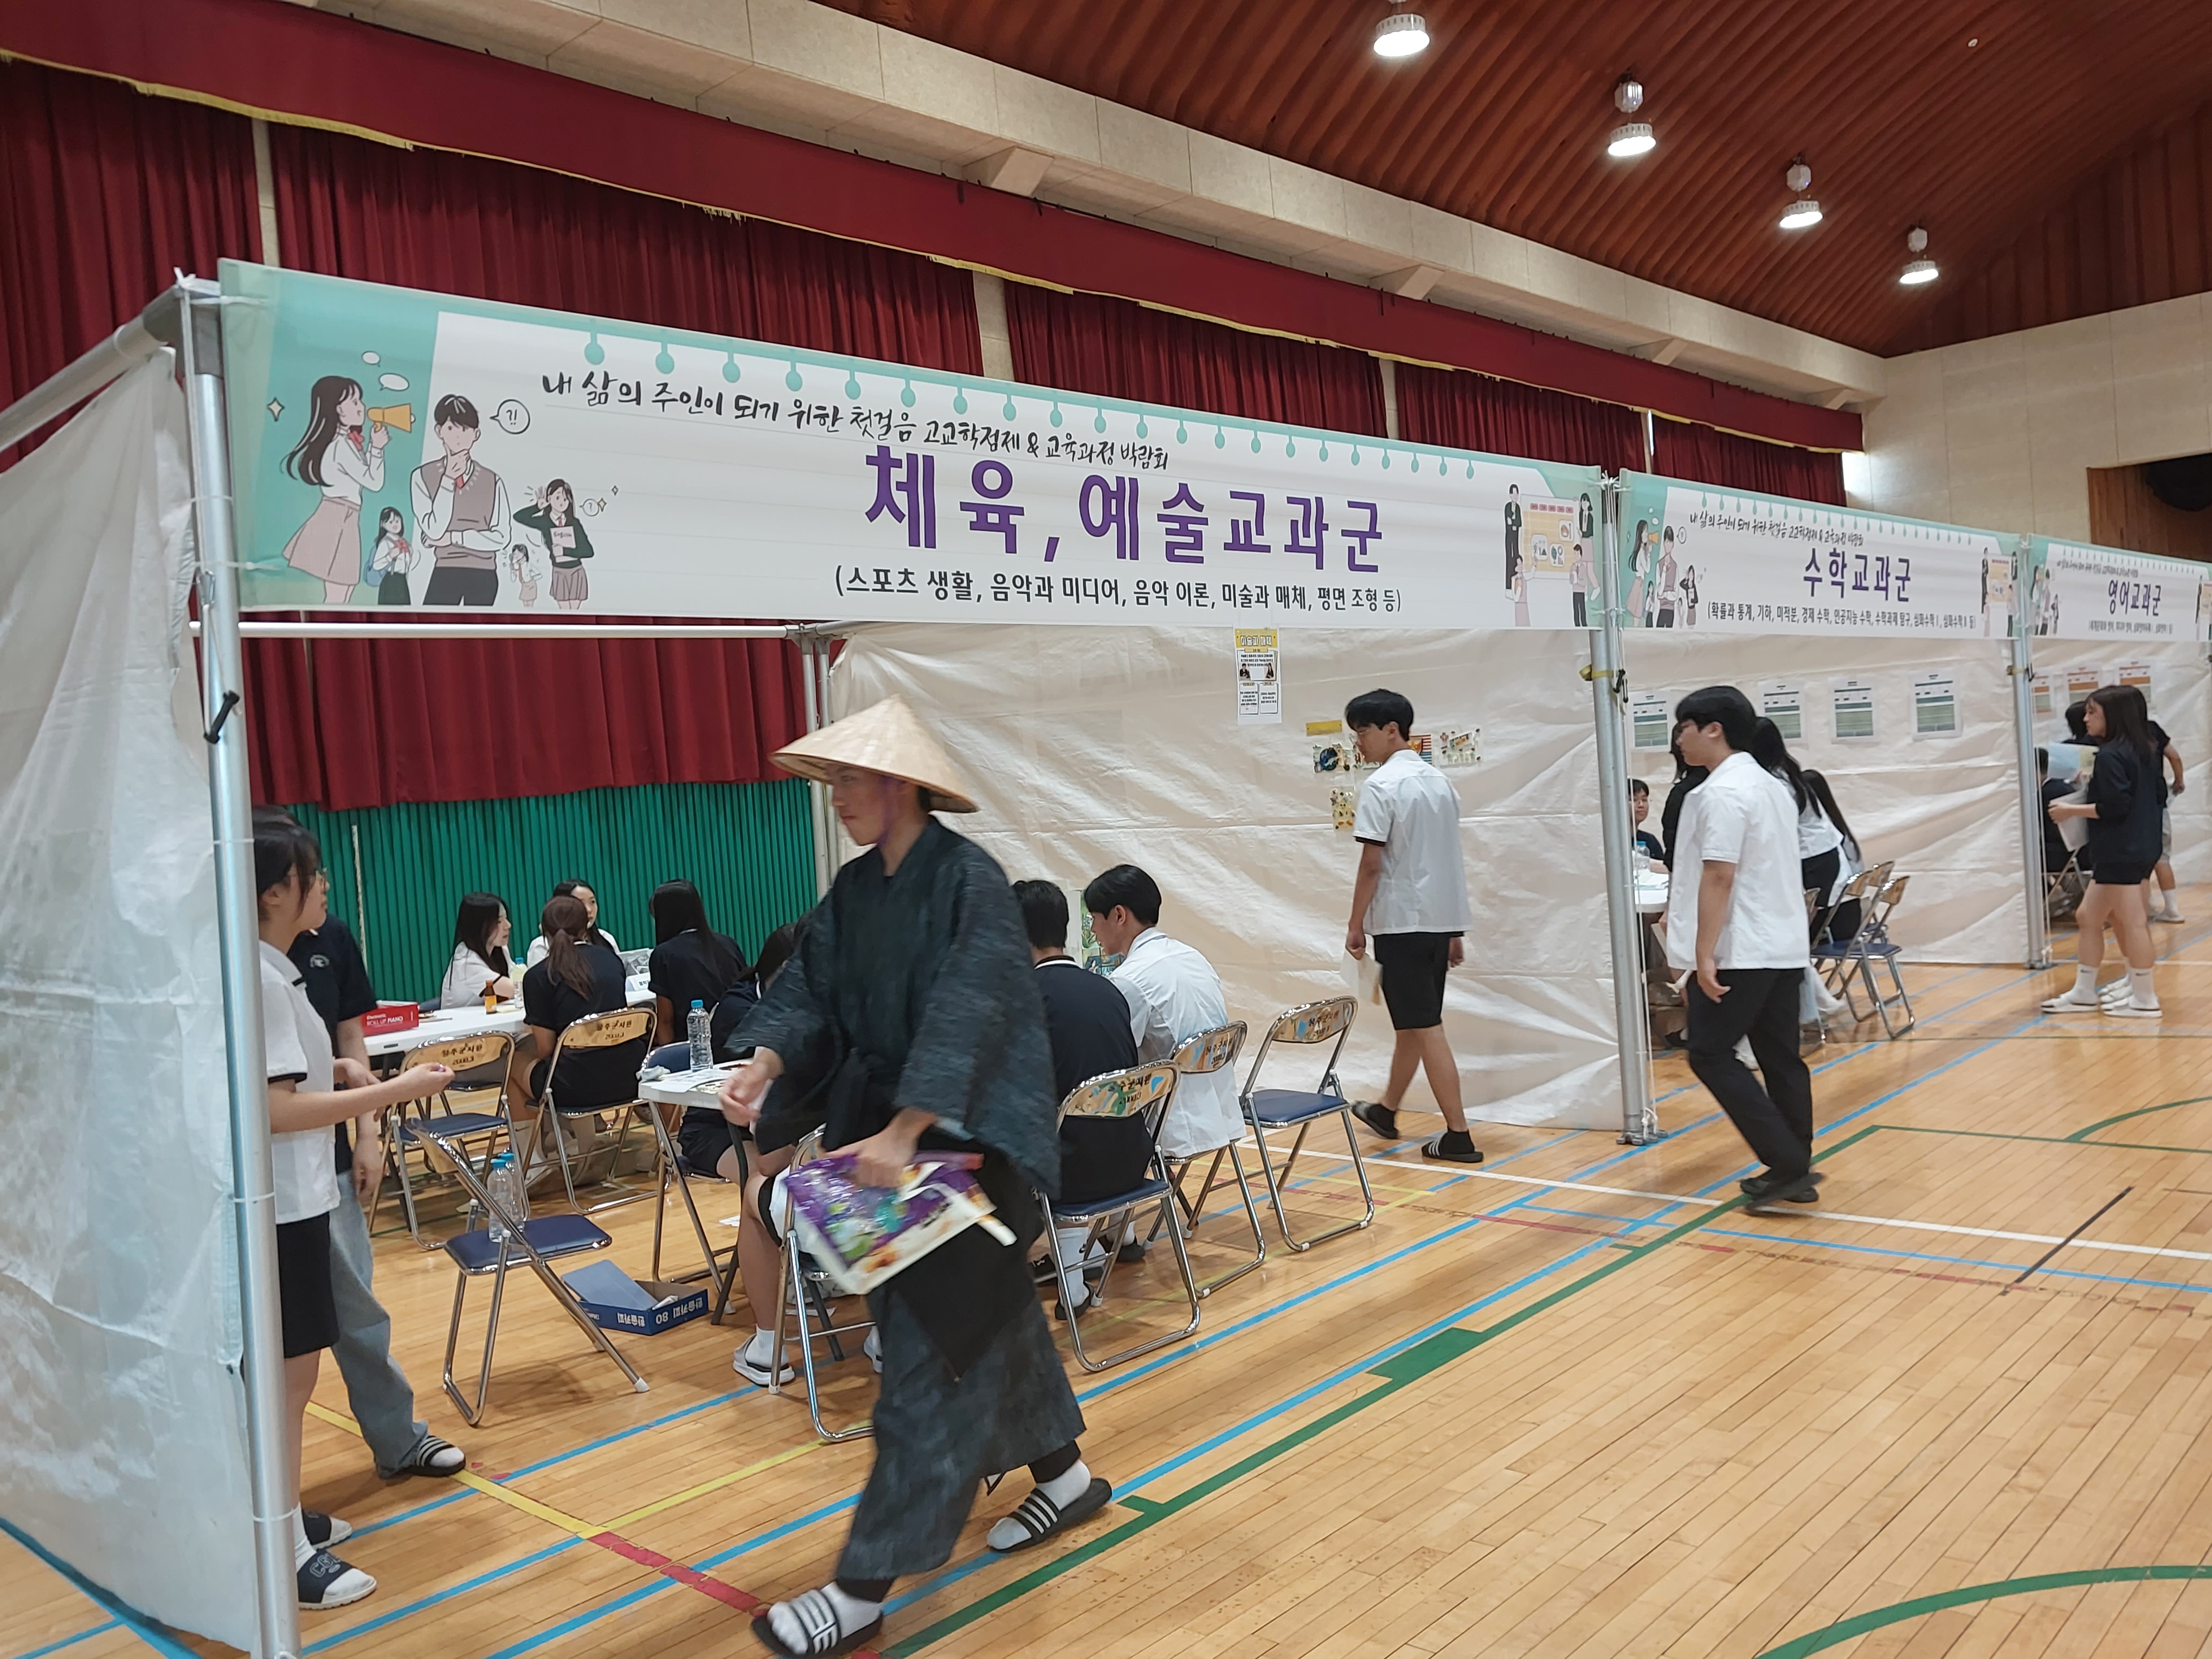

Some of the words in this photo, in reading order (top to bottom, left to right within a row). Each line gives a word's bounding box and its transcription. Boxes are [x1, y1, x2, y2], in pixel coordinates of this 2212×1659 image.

[542, 372, 571, 395] 내
[582, 370, 642, 407] 삶의
[652, 382, 723, 416] 주인이
[734, 394, 779, 422] 되기
[788, 399, 844, 432] 위한
[850, 406, 917, 442] 첫걸음
[923, 420, 1020, 453] 고교학점제
[1026, 432, 1039, 459] &
[1045, 434, 1115, 466] 교육과정
[1120, 441, 1168, 471] 박람회
[865, 445, 1060, 562] 체육,
[1079, 473, 1382, 573] 예술교과군
[1690, 512, 1697, 523] 내
[1700, 510, 1715, 529] 삶의
[1717, 515, 1735, 530] 주인이
[1738, 518, 1750, 531] 되기
[1752, 519, 1767, 536] 위한
[835, 564, 919, 597] (스포츠
[927, 569, 982, 602] 생활,
[991, 573, 1054, 602] 음악과
[1063, 576, 1127, 608] 미디어,
[1133, 579, 1169, 606] 음악
[1176, 581, 1216, 609] 이론,
[1222, 583, 1269, 609] 미술과
[1276, 585, 1312, 611] 매체,
[1317, 587, 1346, 610] 평면
[1352, 588, 1378, 612] 조형
[1383, 589, 1400, 612] 등)
[1804, 548, 1911, 602] 수학교과군
[1708, 601, 1735, 620] (확률과
[1738, 603, 1755, 622] 통계,
[1757, 605, 1774, 622] 기하,
[1777, 606, 1800, 623] 미적분,
[1802, 607, 1815, 623] 경제
[1817, 608, 1832, 625] 수학,
[1834, 608, 1858, 625] 인공지능
[1860, 610, 1874, 626] 수학,
[2108, 580, 2161, 616] 영어교과군
[617, 1312, 646, 1327] 한솔카피
[655, 1311, 668, 1324] 80
